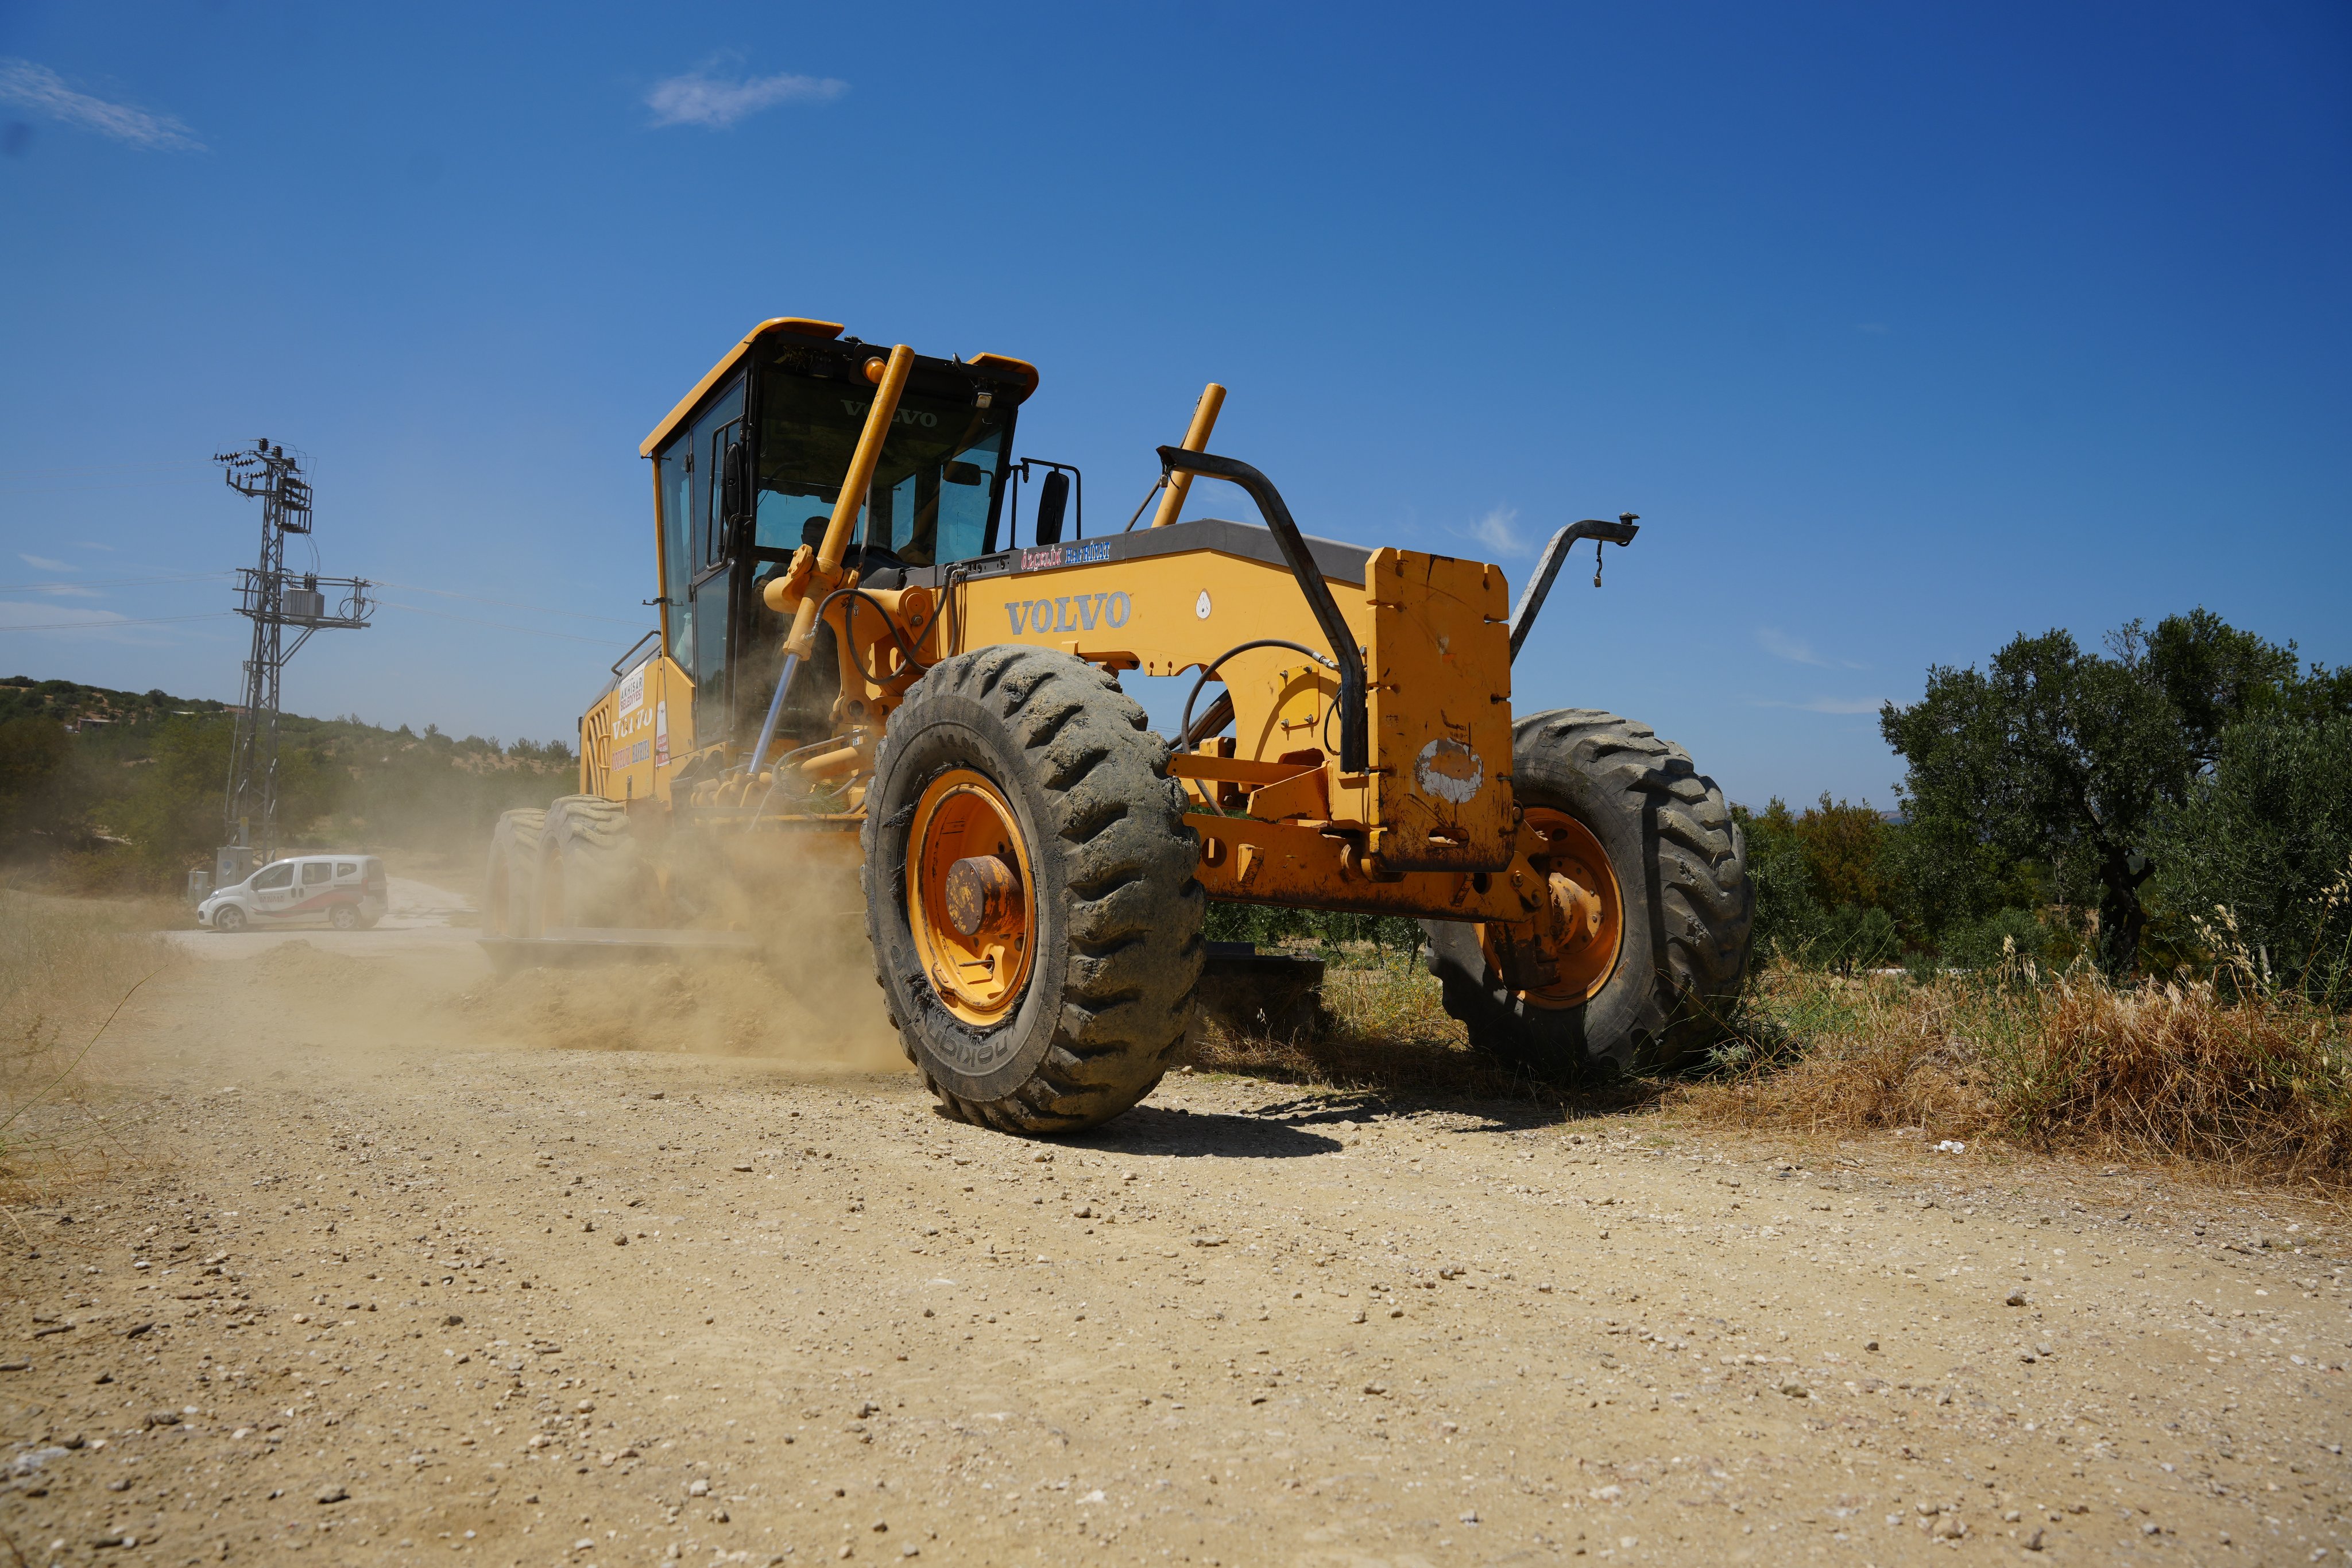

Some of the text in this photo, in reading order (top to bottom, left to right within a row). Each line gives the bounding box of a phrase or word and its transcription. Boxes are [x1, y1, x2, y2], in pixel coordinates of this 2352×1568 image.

[840, 399, 938, 428] VVO
[1021, 540, 1111, 571] ÖZÇELİK HAFRİYAT
[1004, 591, 1131, 636] VOLVO
